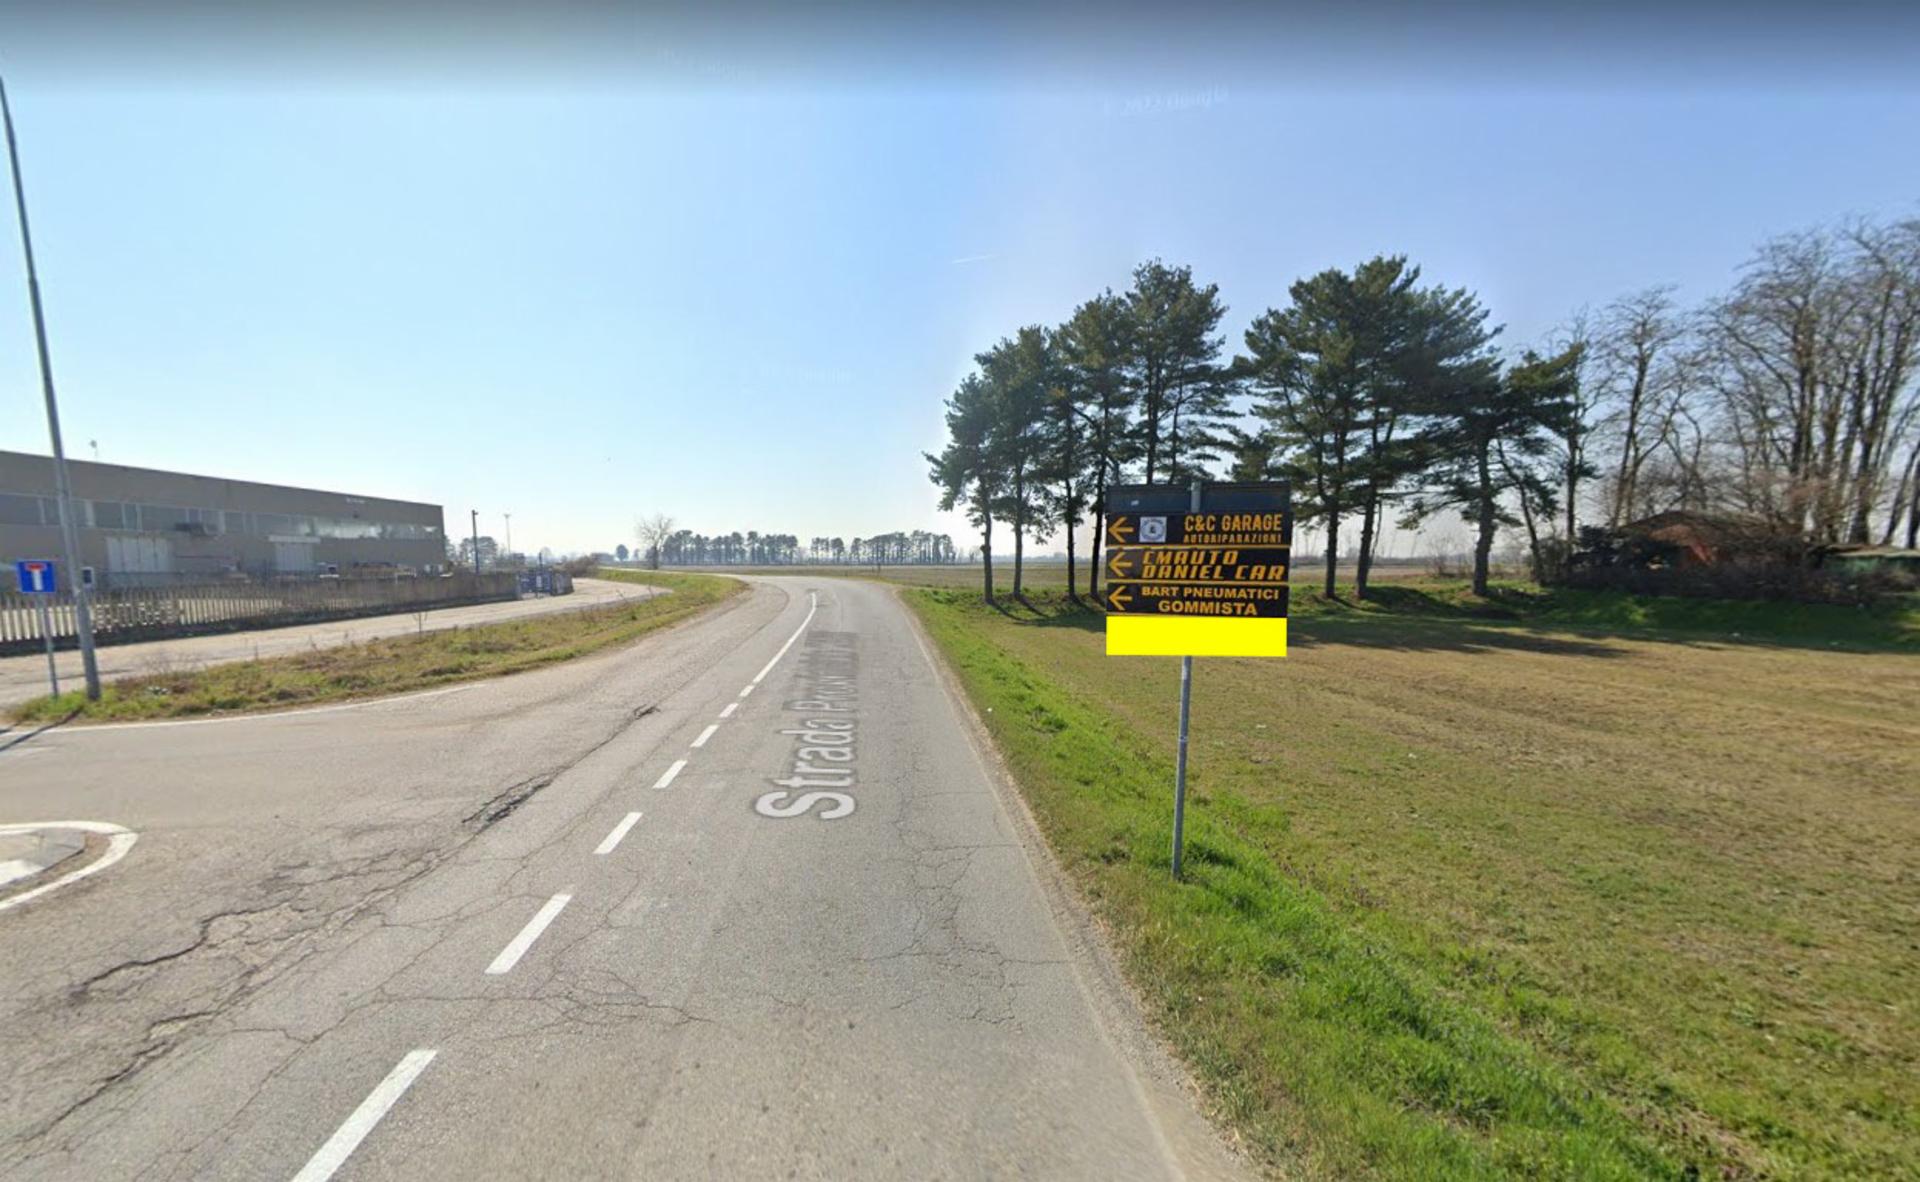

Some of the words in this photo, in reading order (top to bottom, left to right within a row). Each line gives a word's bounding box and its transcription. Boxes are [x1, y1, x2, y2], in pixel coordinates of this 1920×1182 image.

[1184, 515, 1216, 532] C&C
[1221, 514, 1283, 531] GARAGE
[1141, 565, 1224, 580] DANIEL
[1234, 565, 1286, 581] CAR
[1141, 586, 1180, 597] BART
[1183, 587, 1279, 600] PNEUMATICI
[1158, 601, 1258, 616] GOMMISTA
